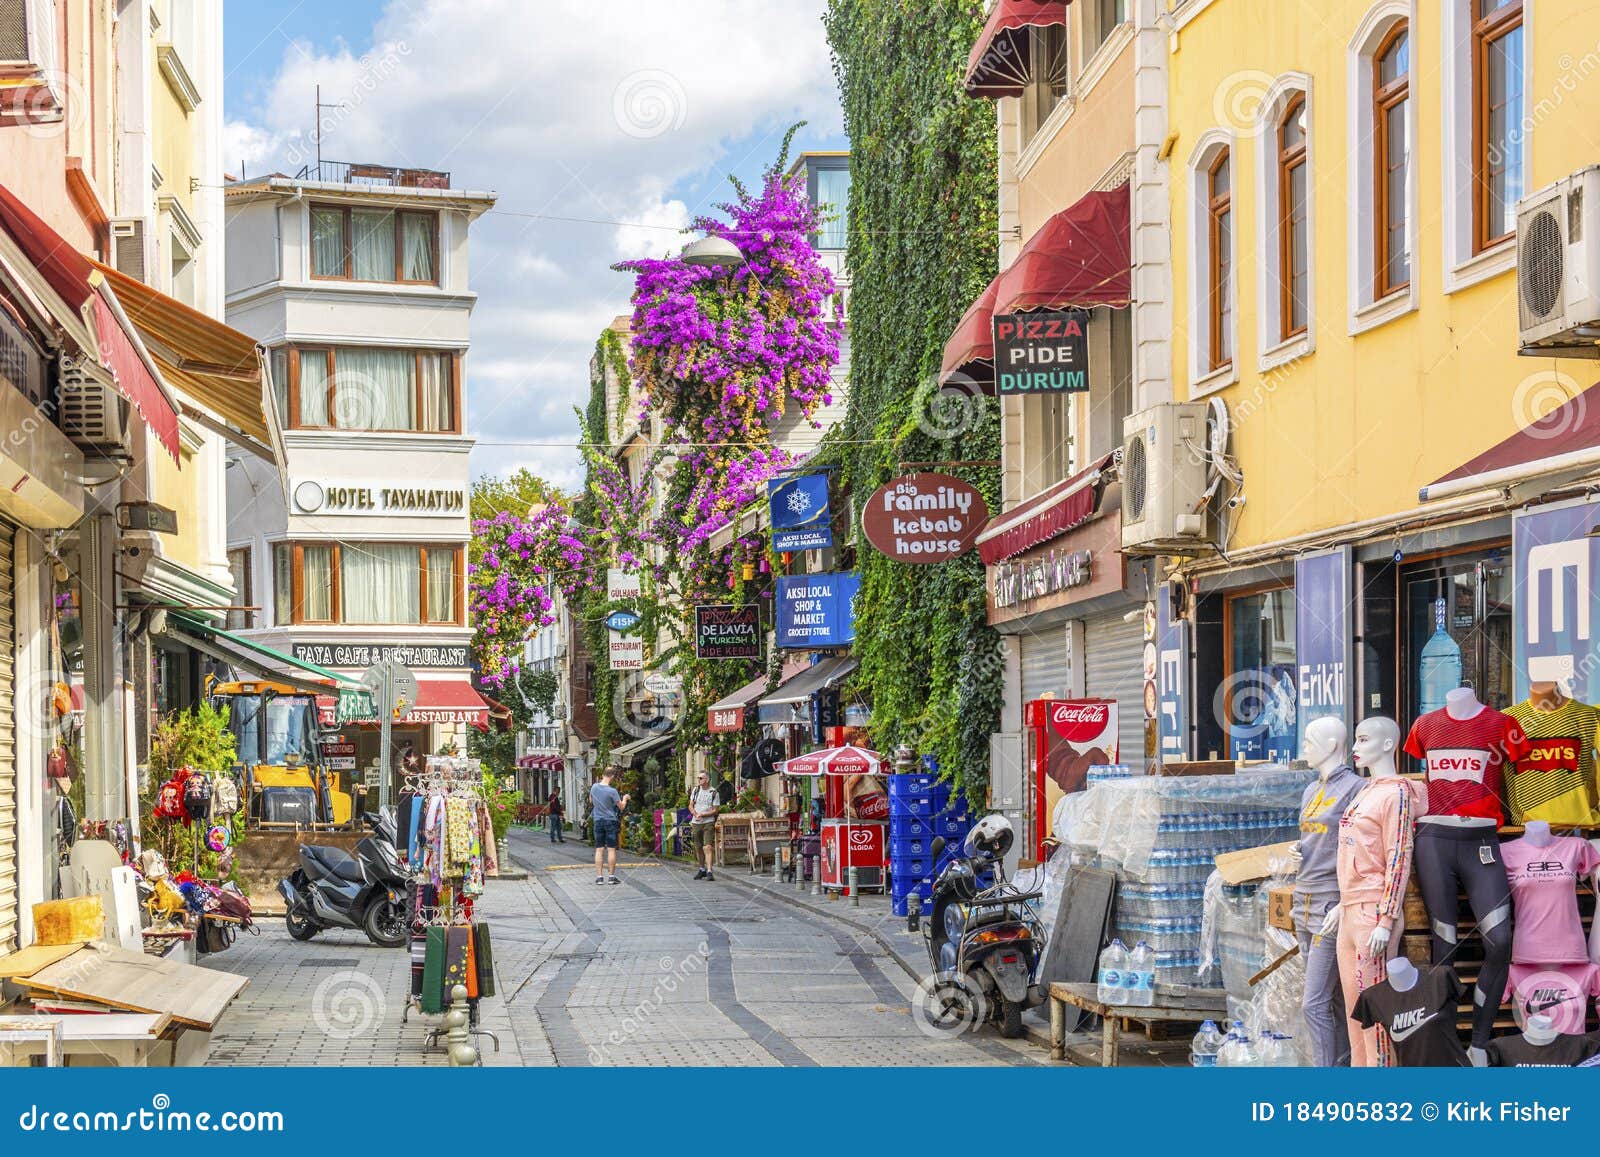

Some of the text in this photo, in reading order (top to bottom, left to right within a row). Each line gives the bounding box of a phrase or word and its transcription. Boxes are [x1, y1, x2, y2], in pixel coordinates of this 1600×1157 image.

[1010, 343, 1073, 365] PİDE
[1001, 368, 1084, 390] DÜRÜM
[327, 487, 464, 511] HOTEL TAYAHATUN
[893, 516, 962, 534] kebab
[799, 532, 821, 540] LOCAL
[800, 538, 827, 546] MARKET
[896, 538, 961, 554] house
[786, 586, 832, 599] AKSU LOCAL
[794, 600, 822, 612] SHOP &
[612, 617, 635, 626] FISH
[793, 613, 825, 625] MARKET
[702, 624, 717, 635] DE
[787, 627, 831, 637] GROCERY STORE
[296, 646, 334, 665] TAYA
[335, 646, 370, 665] CAFE
[382, 646, 467, 666] RESTAURANT
[612, 660, 641, 668] TERRACE
[1299, 662, 1344, 708] Erikli
[406, 711, 480, 723] RESTAURANT
[1053, 704, 1107, 723] Coca-Cola
[792, 764, 814, 772] ALGIDA
[834, 764, 863, 773] ALGIDA
[1531, 988, 1568, 1002] NIKE
[1392, 1007, 1426, 1031] NIKE
